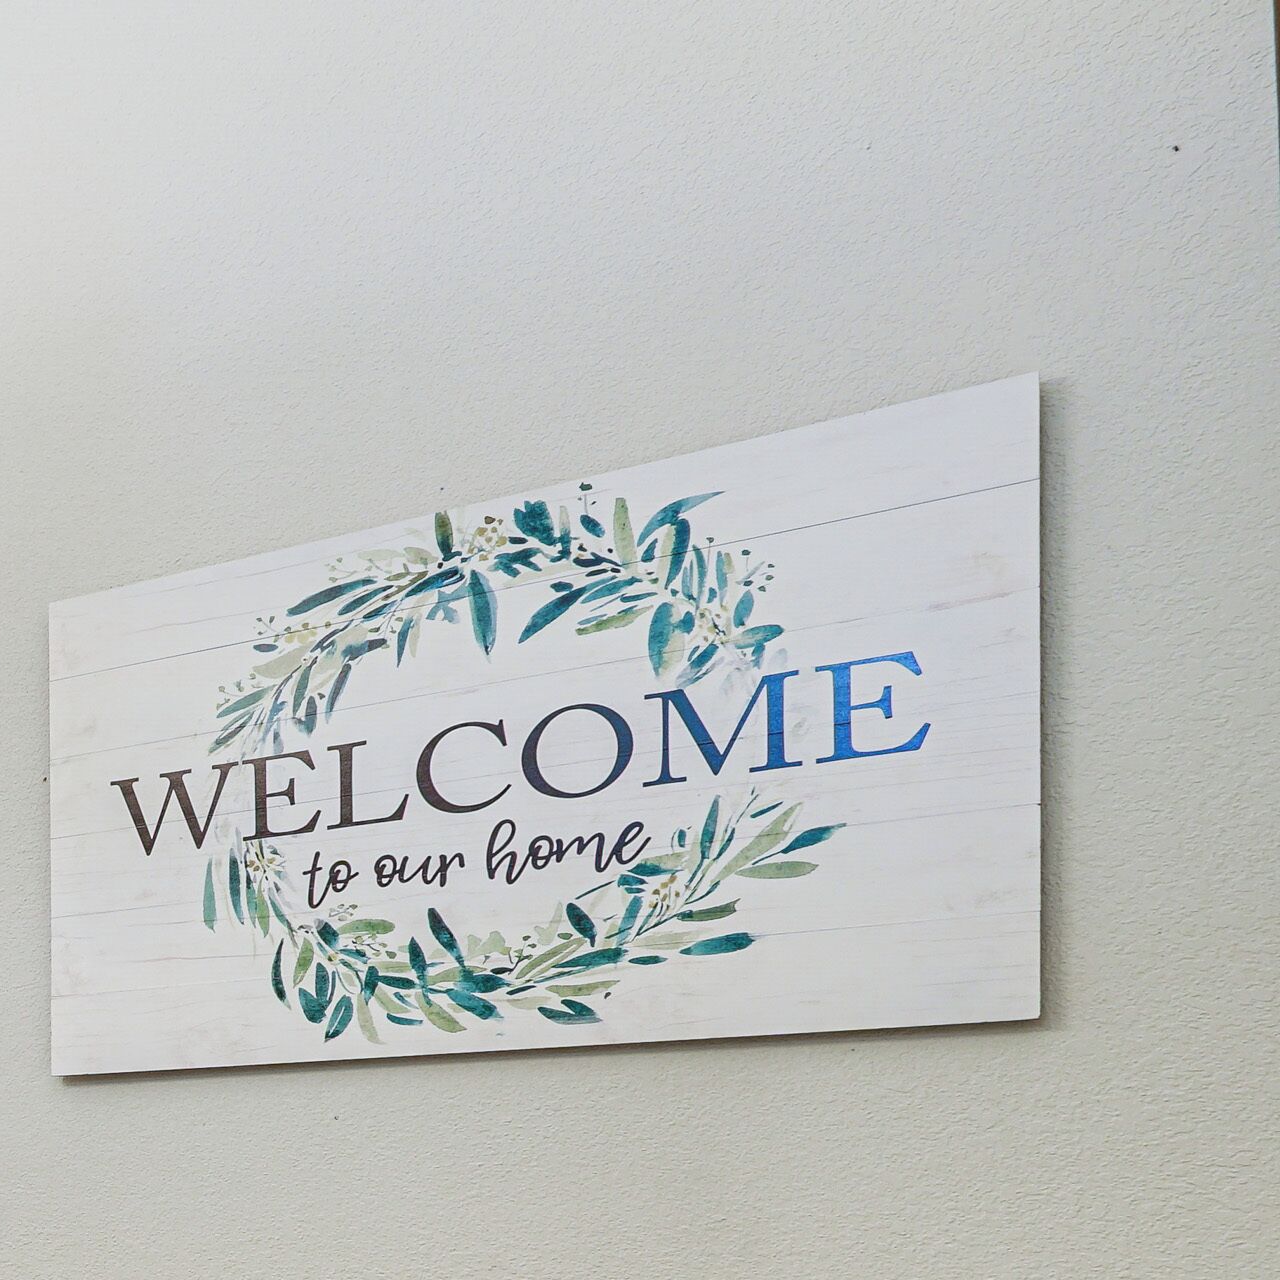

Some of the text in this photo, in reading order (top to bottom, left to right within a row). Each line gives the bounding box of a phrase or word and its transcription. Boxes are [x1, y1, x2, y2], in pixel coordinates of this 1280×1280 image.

[110, 650, 932, 859] WELCOME
[303, 817, 653, 910] to our home
